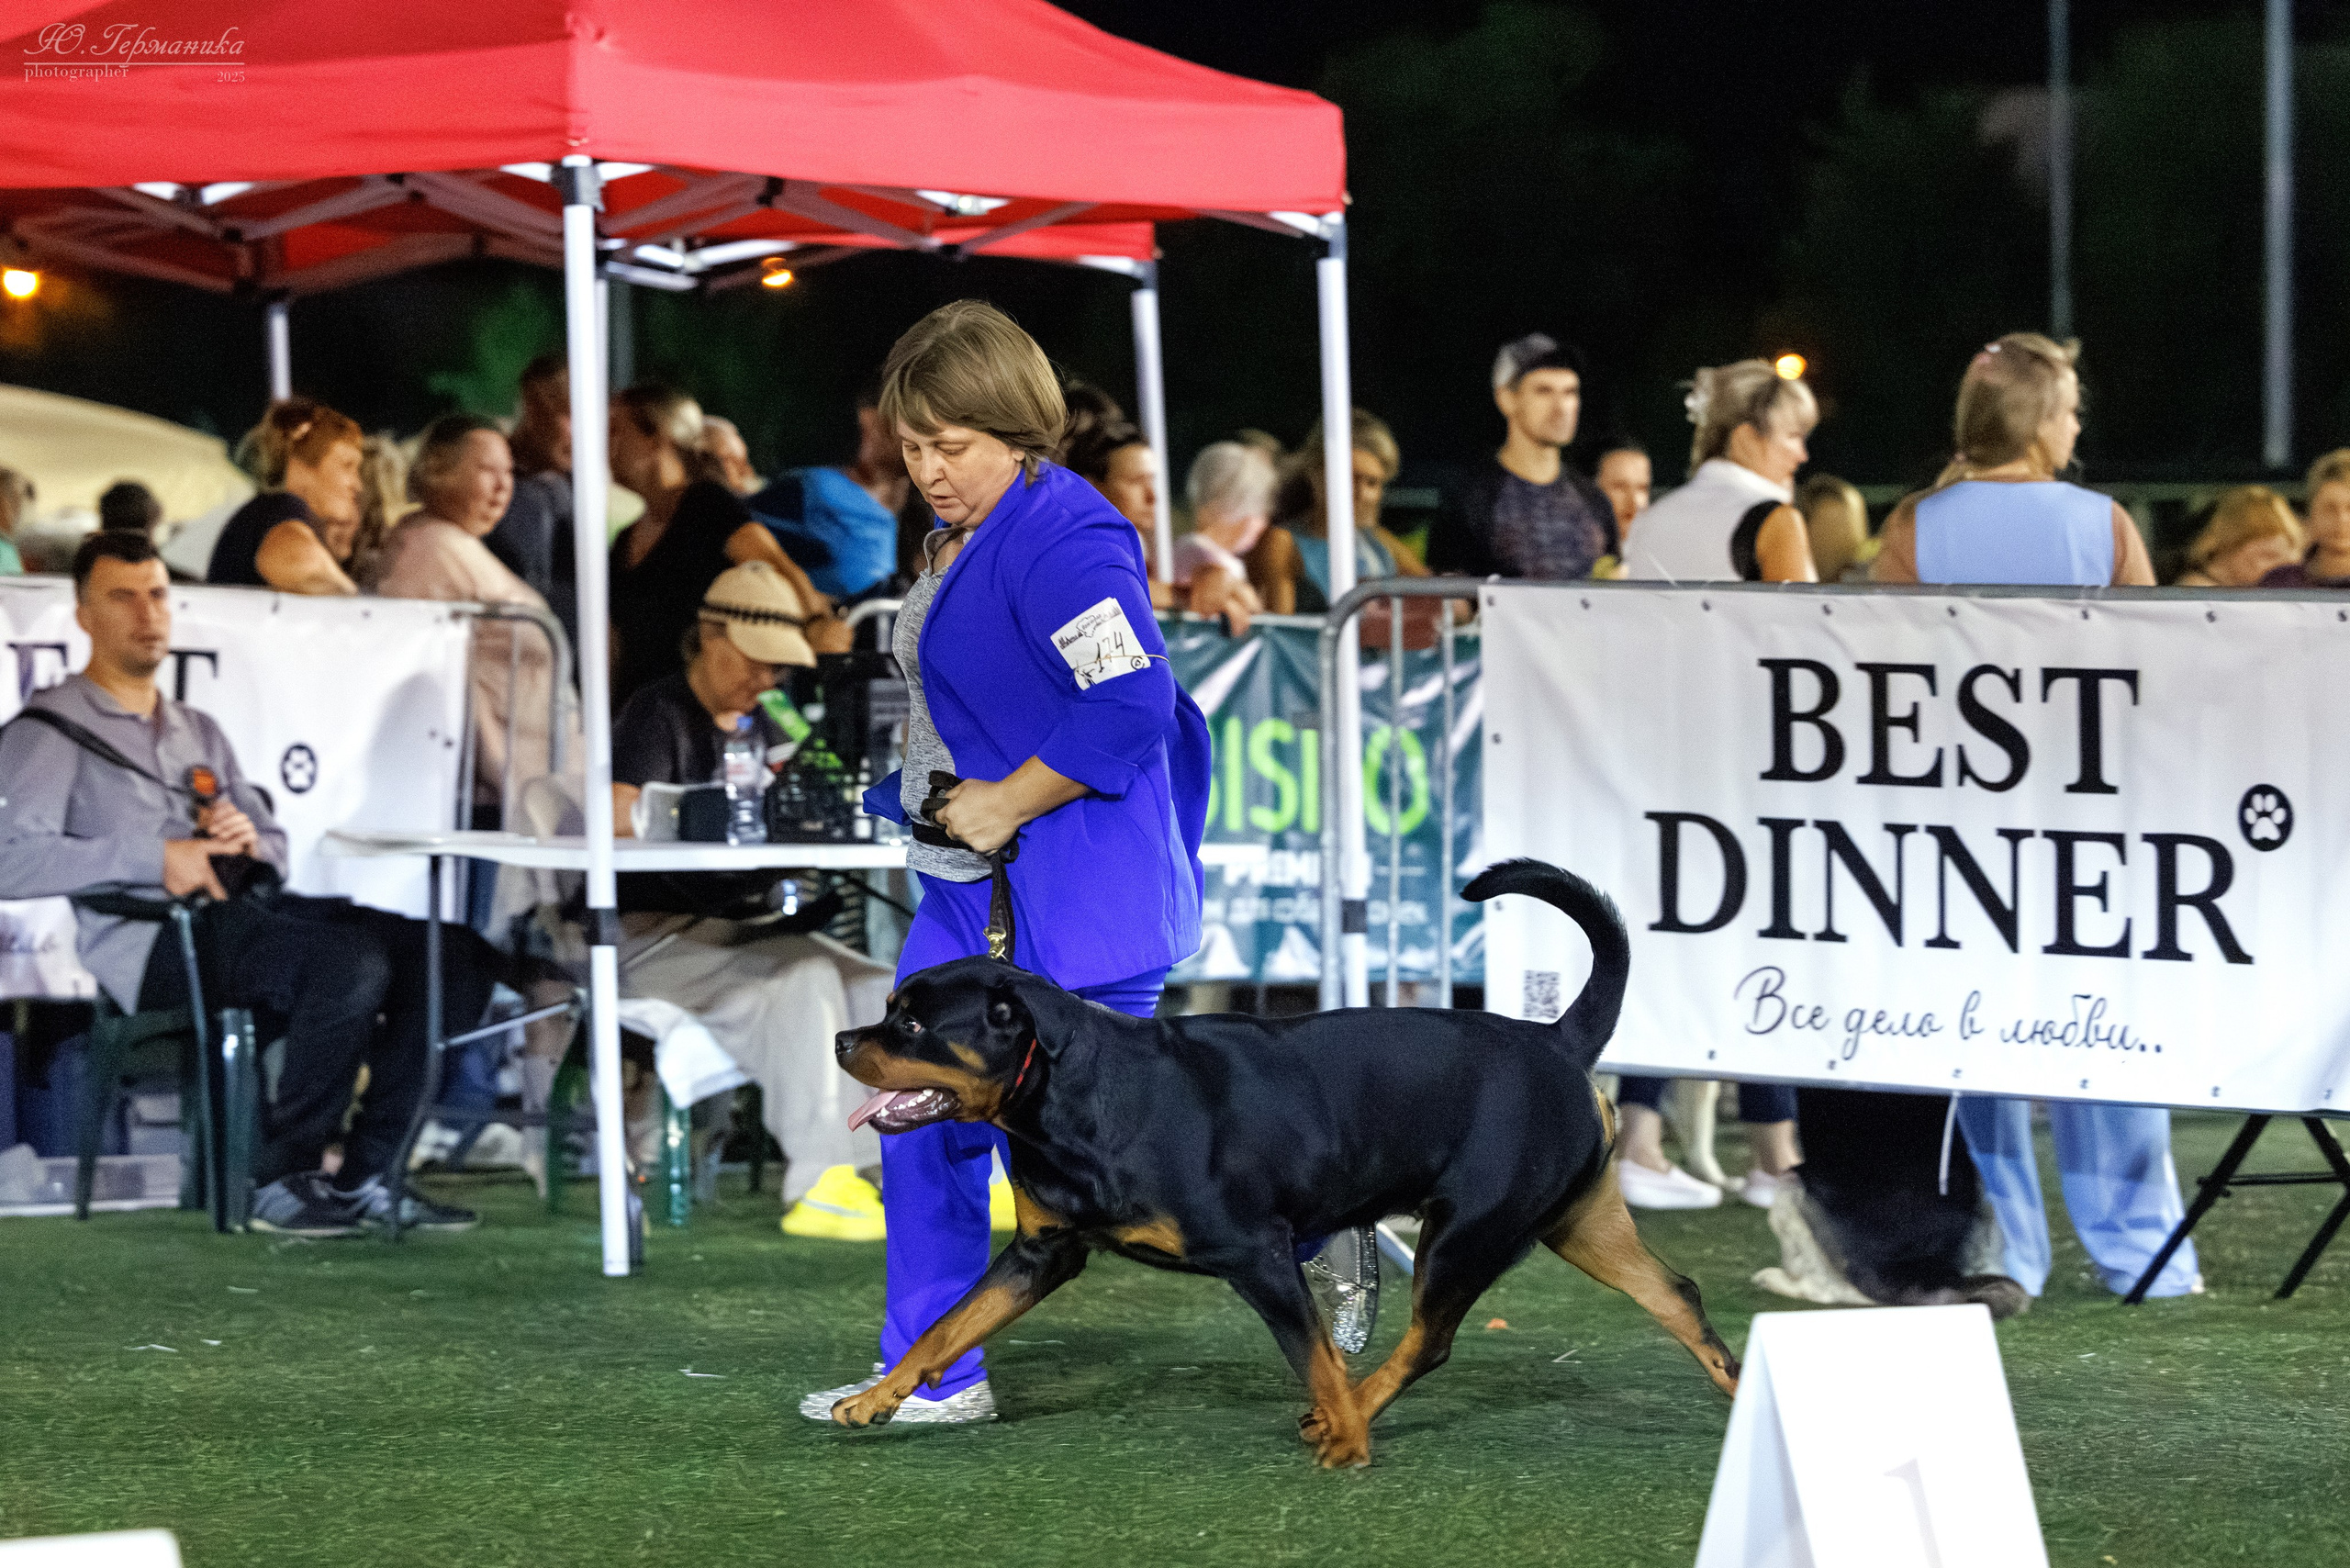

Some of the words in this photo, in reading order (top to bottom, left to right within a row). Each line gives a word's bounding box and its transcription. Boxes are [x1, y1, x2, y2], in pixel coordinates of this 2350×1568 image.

[1757, 657, 2140, 795] BEST
[1644, 810, 2255, 966] DINNER
[1734, 966, 1830, 1035] Все
[1840, 1007, 1943, 1060] дело
[1959, 990, 1984, 1040] в
